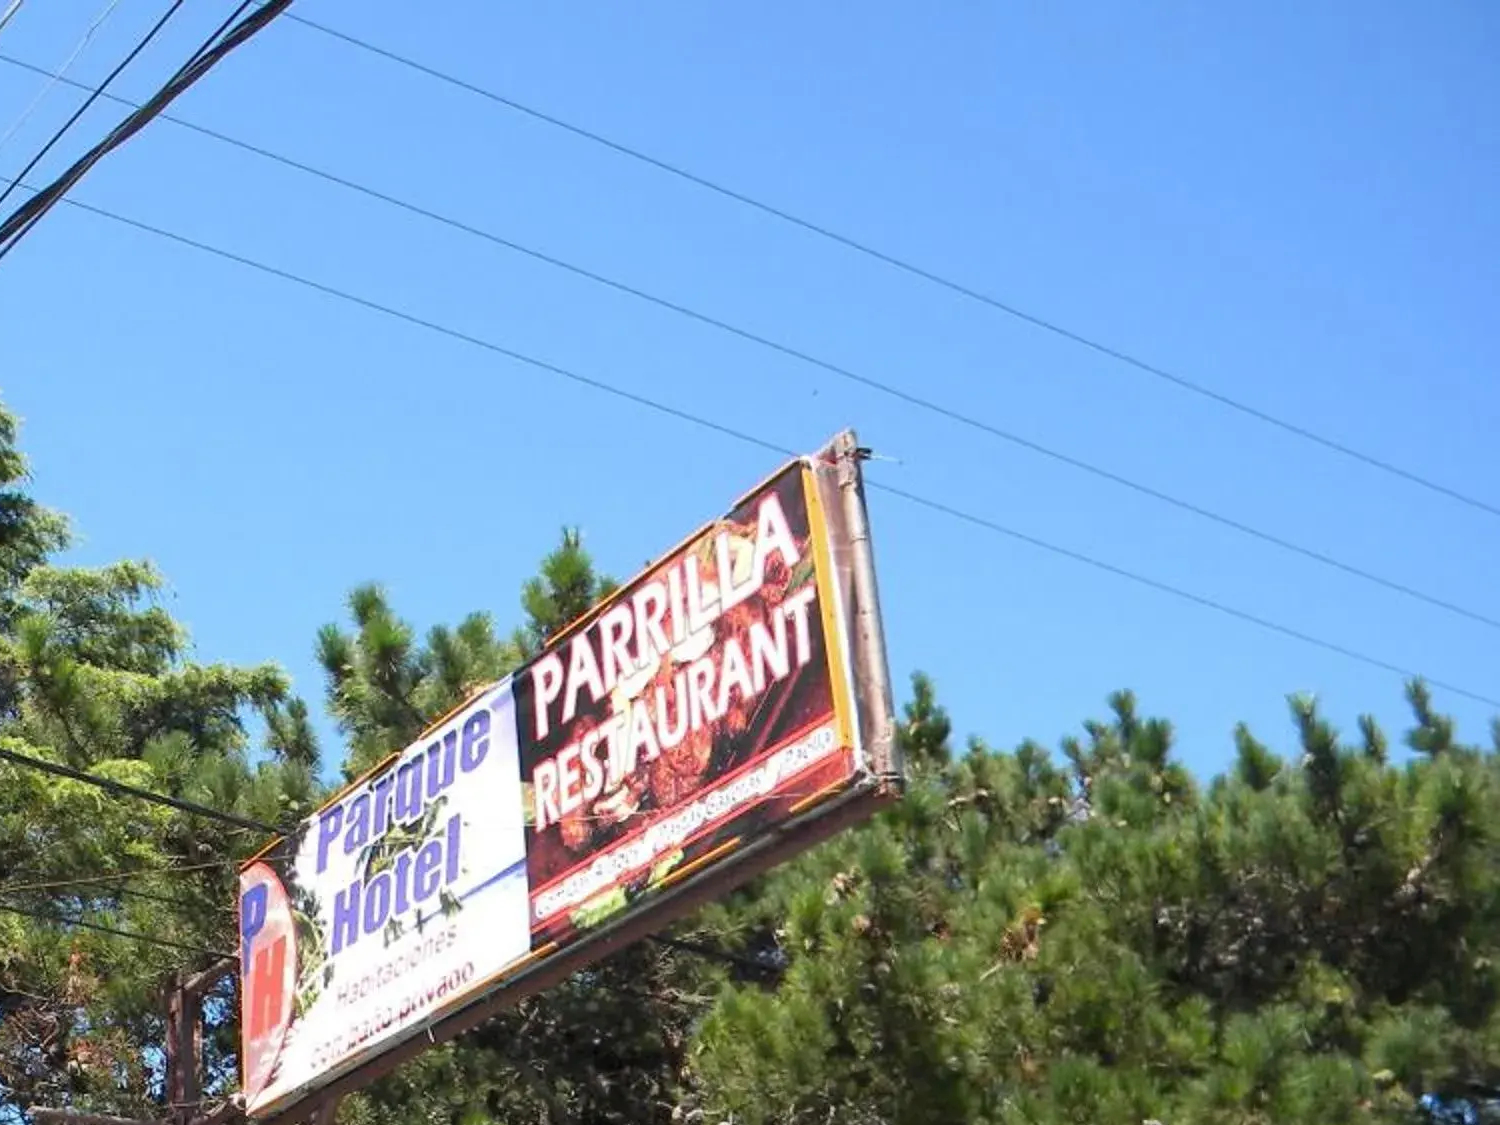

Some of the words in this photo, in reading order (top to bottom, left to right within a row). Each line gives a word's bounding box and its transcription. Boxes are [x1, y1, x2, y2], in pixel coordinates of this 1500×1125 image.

[531, 491, 800, 741] PARRILLA
[532, 584, 816, 833] RESTAURANT
[316, 708, 492, 875] Parque
[331, 812, 461, 956] Hotel
